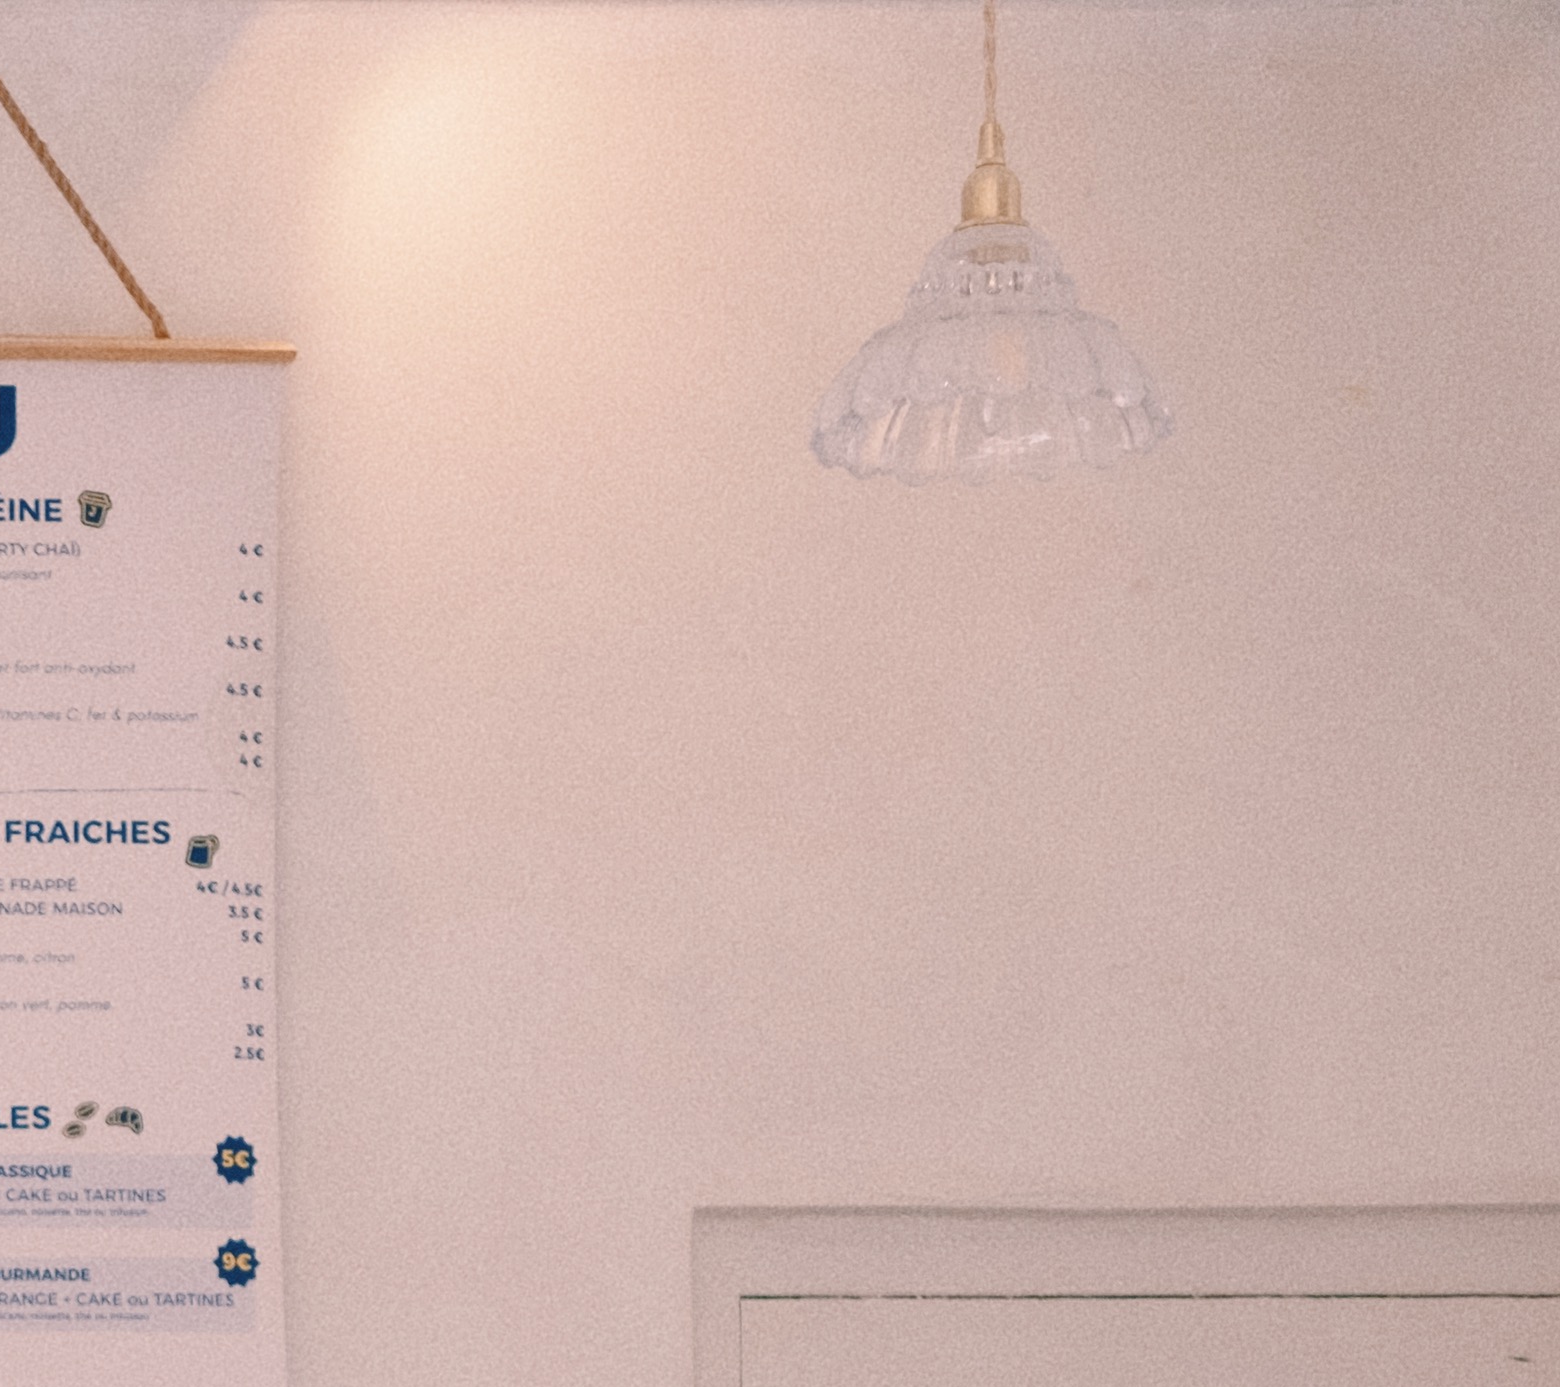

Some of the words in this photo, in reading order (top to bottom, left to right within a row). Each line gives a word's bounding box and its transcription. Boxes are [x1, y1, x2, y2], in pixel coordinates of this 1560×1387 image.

[4, 820, 170, 844] FRAICHES
[52, 902, 123, 916] MAISON
[76, 1292, 122, 1307] CAKE
[153, 1292, 234, 1307] TARTINES
